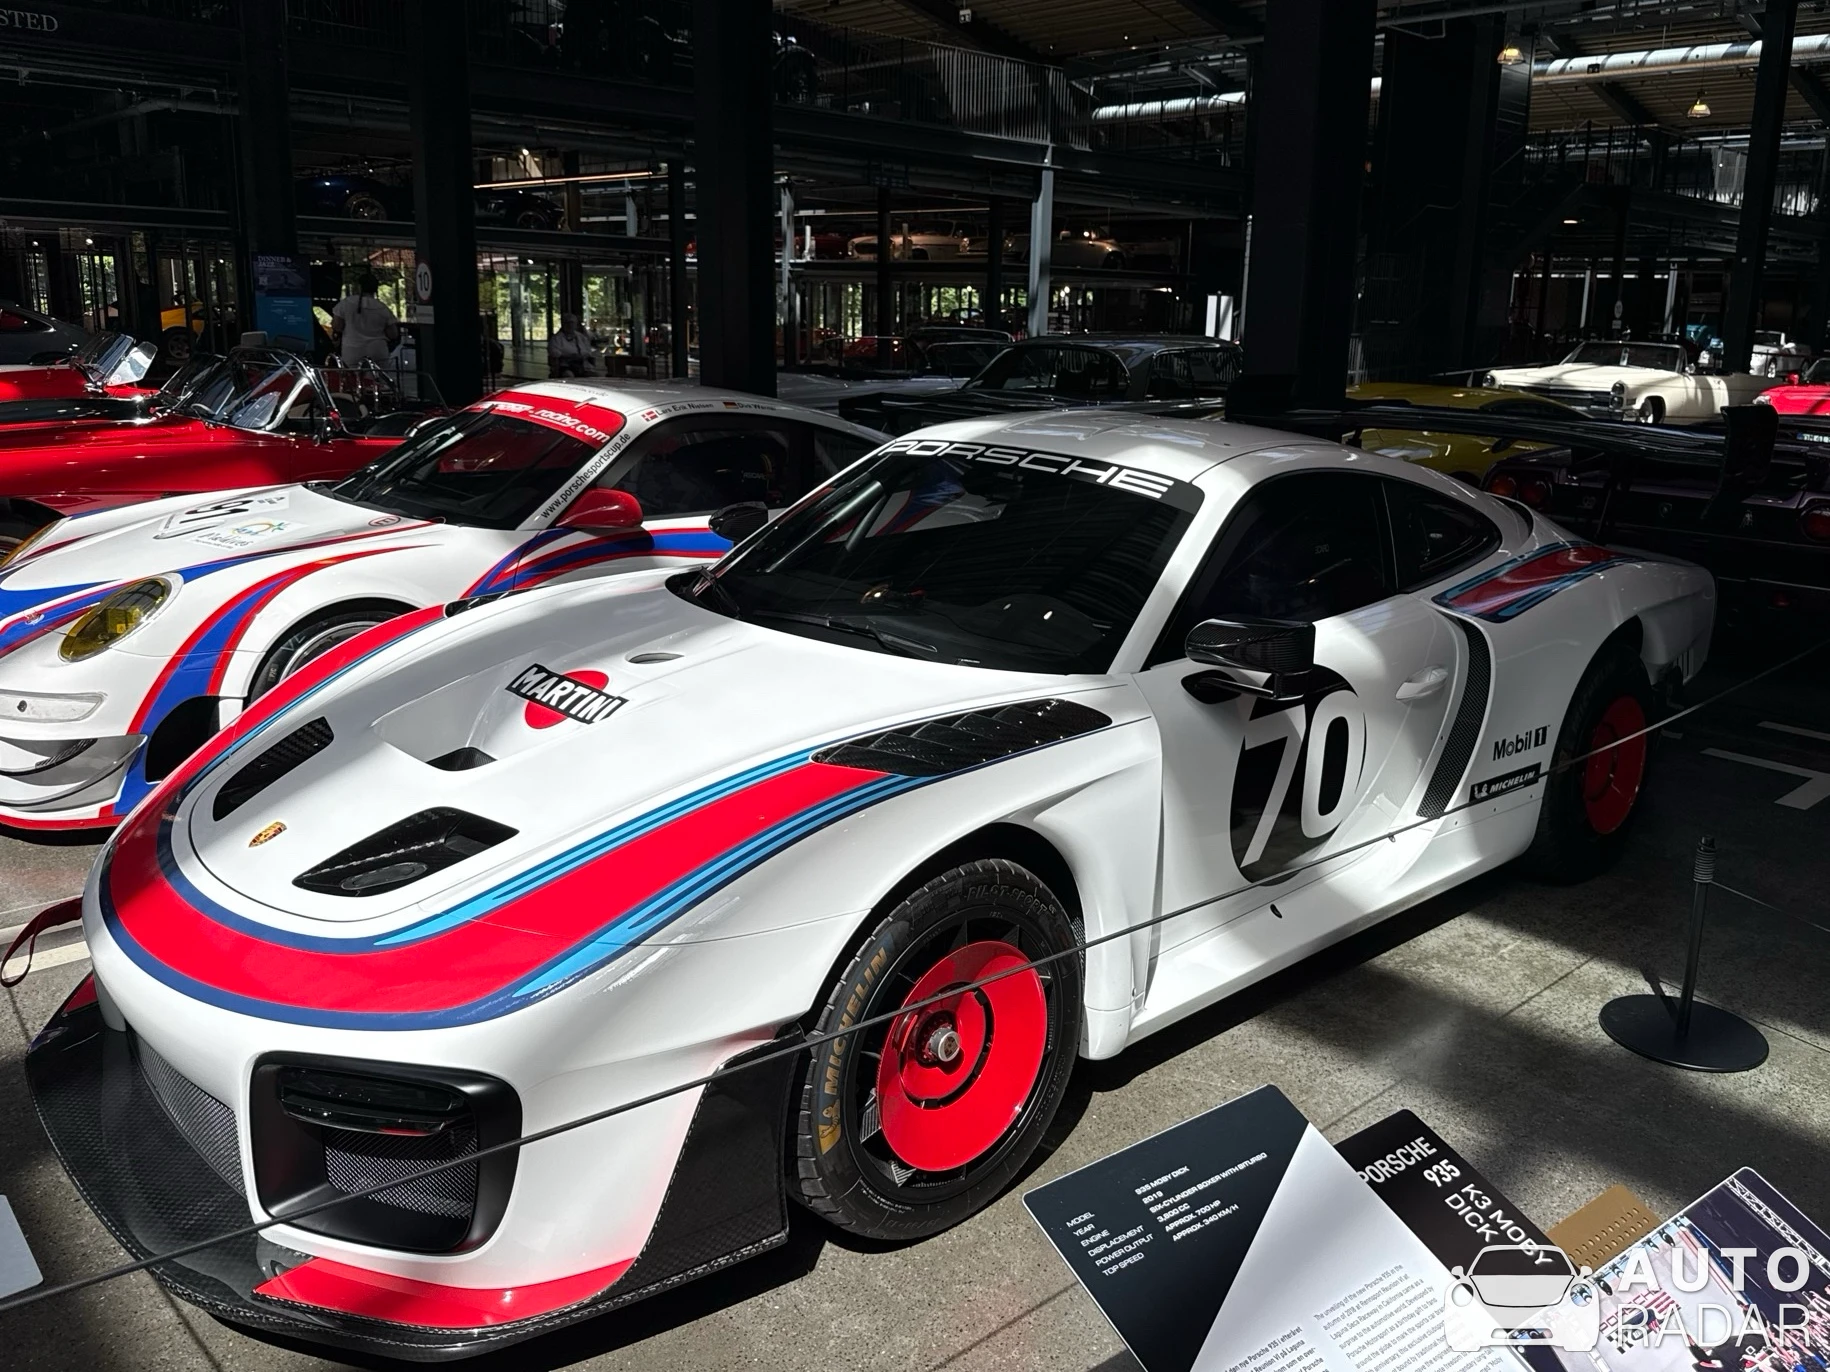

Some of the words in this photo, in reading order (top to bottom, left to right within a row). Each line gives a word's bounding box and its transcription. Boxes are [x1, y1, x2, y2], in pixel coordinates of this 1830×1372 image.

[0, 9, 58, 31] STED
[419, 271, 431, 292] 10
[656, 408, 672, 416] Lars
[672, 404, 688, 412] Erik
[541, 433, 631, 518] www.porschesportscup.de
[878, 440, 1174, 499] PORSCHE
[511, 666, 622, 721] MARTINI
[1493, 730, 1531, 761] Mobil
[1534, 726, 1548, 748] 1
[1239, 690, 1362, 868] 70
[1489, 770, 1536, 794] MICHELIN
[824, 947, 887, 1095] MICHELIN
[1357, 1136, 1437, 1183] PORSCHE
[1423, 1158, 1461, 1187] 935
[1134, 1183, 1152, 1195] 935
[1149, 1173, 1172, 1188] MOBY
[1170, 1165, 1190, 1178] DICK
[1149, 1186, 1199, 1213] SIX-CYLINDER
[1196, 1174, 1222, 1190] BOXER
[1219, 1166, 1239, 1178] WITH
[1236, 1152, 1268, 1170] BITURBO
[1065, 1211, 1095, 1228] MODEL
[1165, 1212, 1197, 1232] APPROX.
[1194, 1204, 1212, 1216] 700
[1209, 1199, 1221, 1209] HP
[1172, 1221, 1205, 1242] APPROX.
[1202, 1214, 1219, 1225] 340
[1216, 1203, 1239, 1218] KM/H
[1177, 1202, 1190, 1212] CC
[1445, 1193, 1499, 1242] DICK
[1072, 1223, 1095, 1237] YEAR
[1080, 1229, 1110, 1247] ENGINE
[1087, 1224, 1144, 1257] DISPLACEMENT
[1461, 1183, 1492, 1209] K3
[1489, 1209, 1554, 1265] MOBY
[1094, 1248, 1126, 1267] POWER
[1123, 1233, 1154, 1253] OUTPUT
[1101, 1264, 1119, 1276] TOP
[1118, 1252, 1145, 1269] SPEED
[1312, 1313, 1325, 1321] The
[1323, 1300, 1346, 1316] unveiling
[1342, 1296, 1350, 1304] of
[1347, 1292, 1358, 1301] the
[1355, 1287, 1367, 1296] new
[1363, 1276, 1384, 1290] Porsche
[1380, 1270, 1392, 1279] 935
[1393, 1264, 1404, 1272] the
[1322, 1316, 1342, 1331] autumn
[1339, 1311, 1347, 1320] of
[1358, 1289, 1384, 1307] Rennsport
[1380, 1279, 1401, 1294] Reunion
[1329, 1326, 1349, 1341] Laguna
[1345, 1319, 1360, 1330] Seca
[1356, 1306, 1380, 1323] Raceway
[1381, 1291, 1404, 1307] California
[1401, 1284, 1415, 1295] came
[1338, 1334, 1359, 1350] surprise
[1361, 1326, 1372, 1335] the
[1369, 1311, 1395, 1330] automotive
[1404, 1288, 1429, 1306] Developed
[1425, 1285, 1435, 1293] by
[1345, 1344, 1367, 1360] Porsche
[1363, 1328, 1391, 1348] Motorsport
[1396, 1311, 1417, 1326] birthday
[1414, 1306, 1424, 1316] gift
[1425, 1297, 1438, 1307] fans
[1238, 1359, 1250, 1369] nye
[1246, 1346, 1270, 1363] Porsche
[1267, 1339, 1279, 1350] 935
[1280, 1326, 1303, 1343] efteråret
[1279, 1348, 1288, 1359] på
[1285, 1339, 1306, 1354] Laguna
[1354, 1354, 1373, 1370] around
[1370, 1350, 1380, 1359] the
[1378, 1342, 1393, 1355] globe
[1395, 1331, 1409, 1342] mark
[1406, 1326, 1416, 1334] the
[1414, 1317, 1430, 1330] sports
[1427, 1312, 1436, 1321] car
[1433, 1304, 1446, 1316] bran
[1397, 1346, 1409, 1355] this
[1406, 1333, 1428, 1349] exclusive
[1285, 1359, 1298, 1369] som
[1303, 1347, 1316, 1358] over-
[1301, 1357, 1324, 1372] Porsche
[1395, 1358, 1412, 1372] bound
[1408, 1355, 1418, 1363] by
[1415, 1340, 1439, 1359] traditional
[1424, 1359, 1434, 1368] the
[1442, 1354, 1463, 1370] freedom
